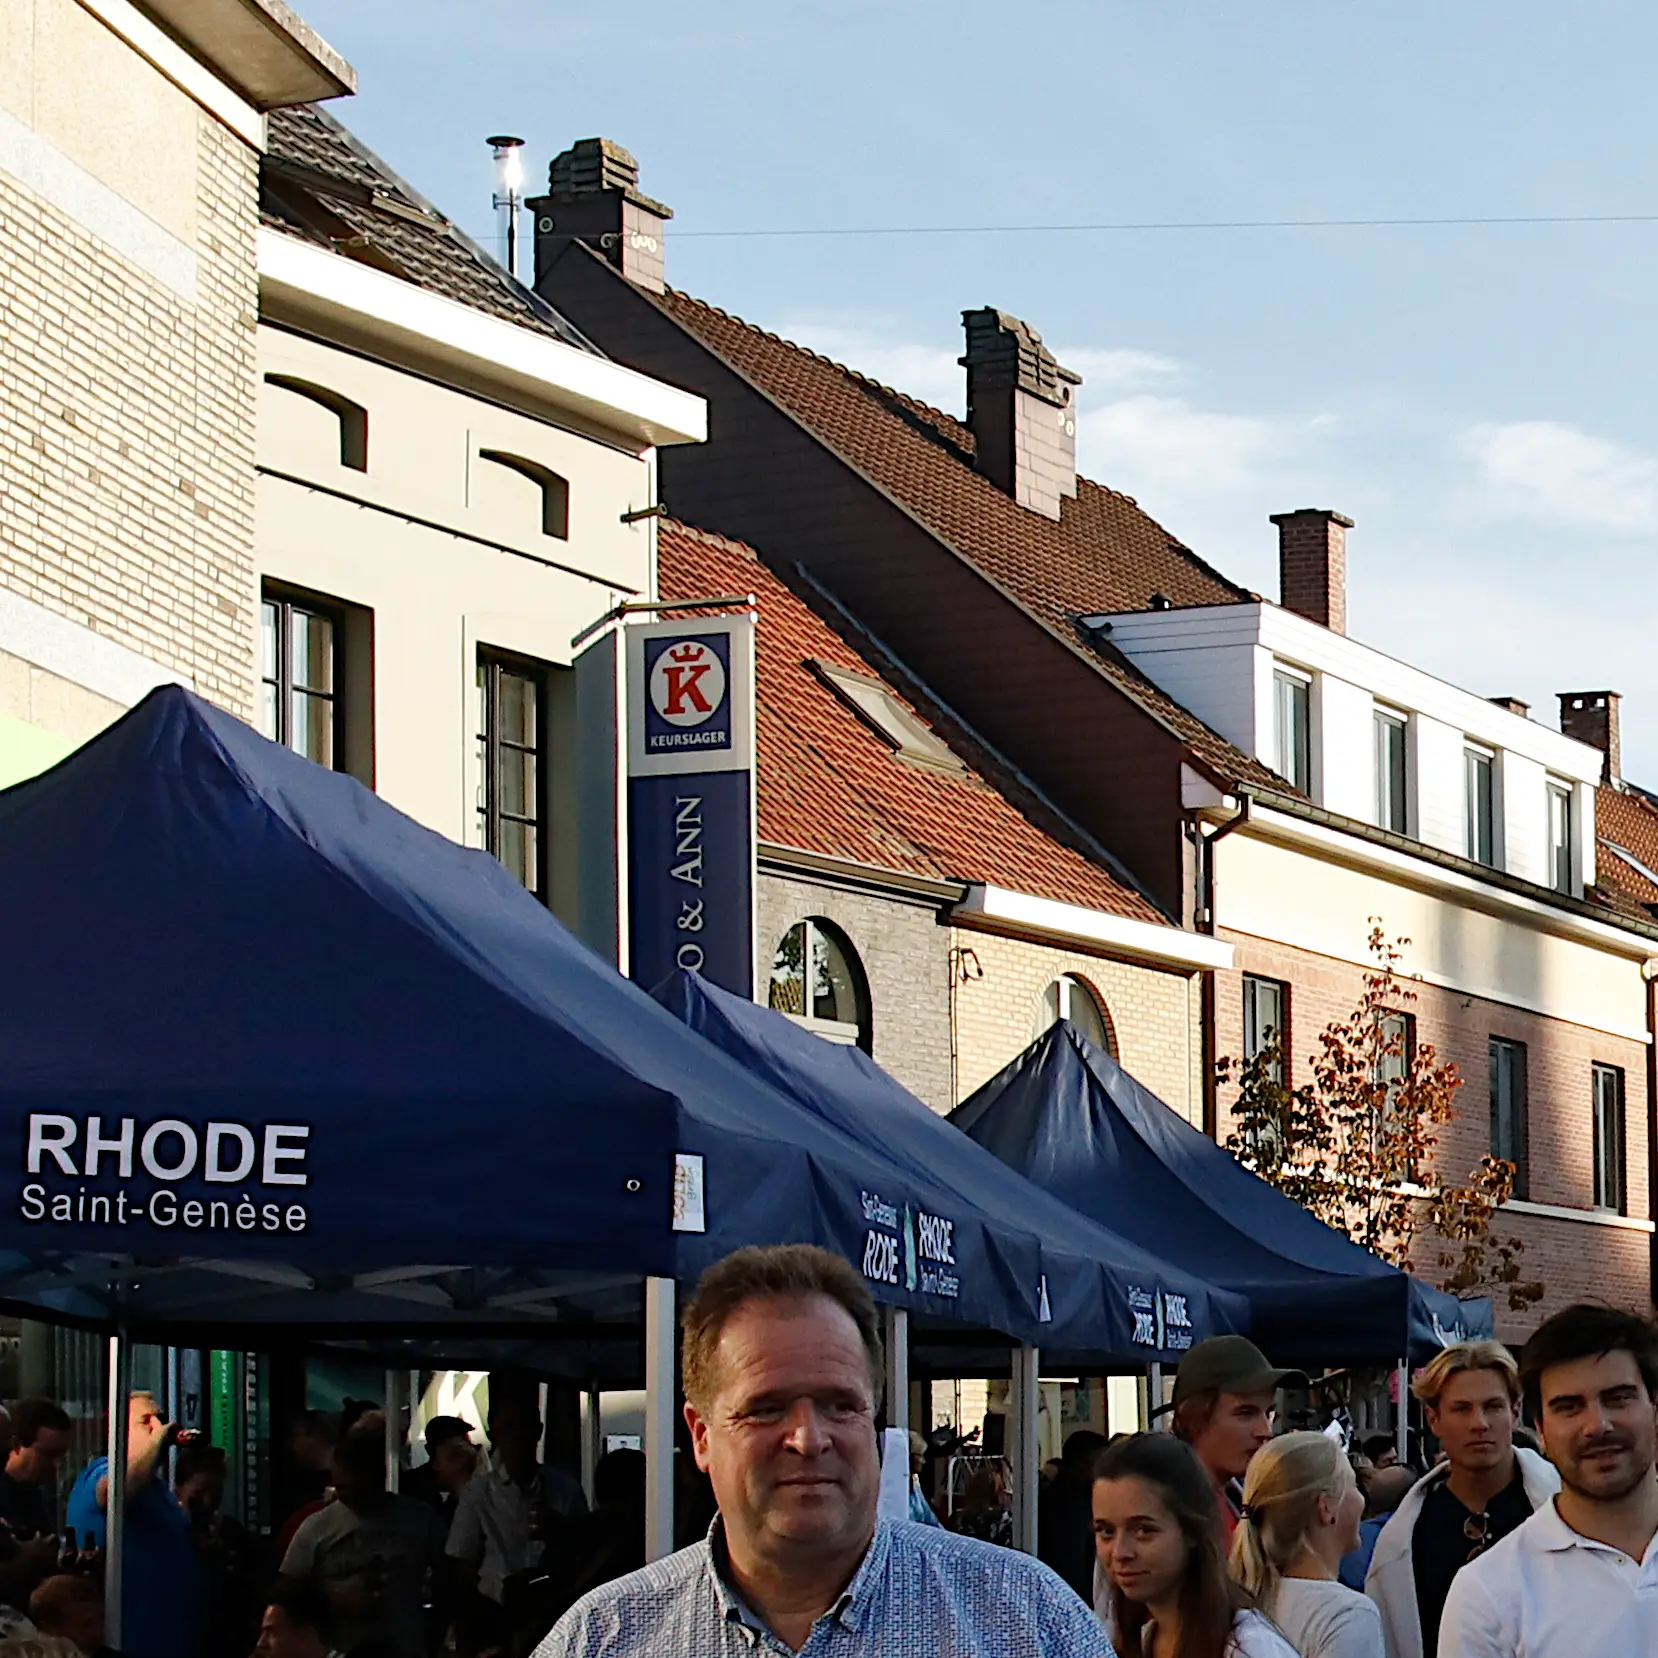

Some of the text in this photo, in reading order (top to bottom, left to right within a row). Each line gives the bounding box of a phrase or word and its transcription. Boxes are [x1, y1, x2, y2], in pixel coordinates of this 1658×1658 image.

[662, 664, 713, 714] K
[650, 731, 726, 748] KEURSLAGER
[670, 795, 703, 888] ANN
[677, 898, 705, 933] &
[28, 1113, 309, 1185] RHODE
[21, 1183, 307, 1232] Saint-Genèse
[862, 1229, 899, 1284] RODE
[918, 1211, 956, 1265] RHODE
